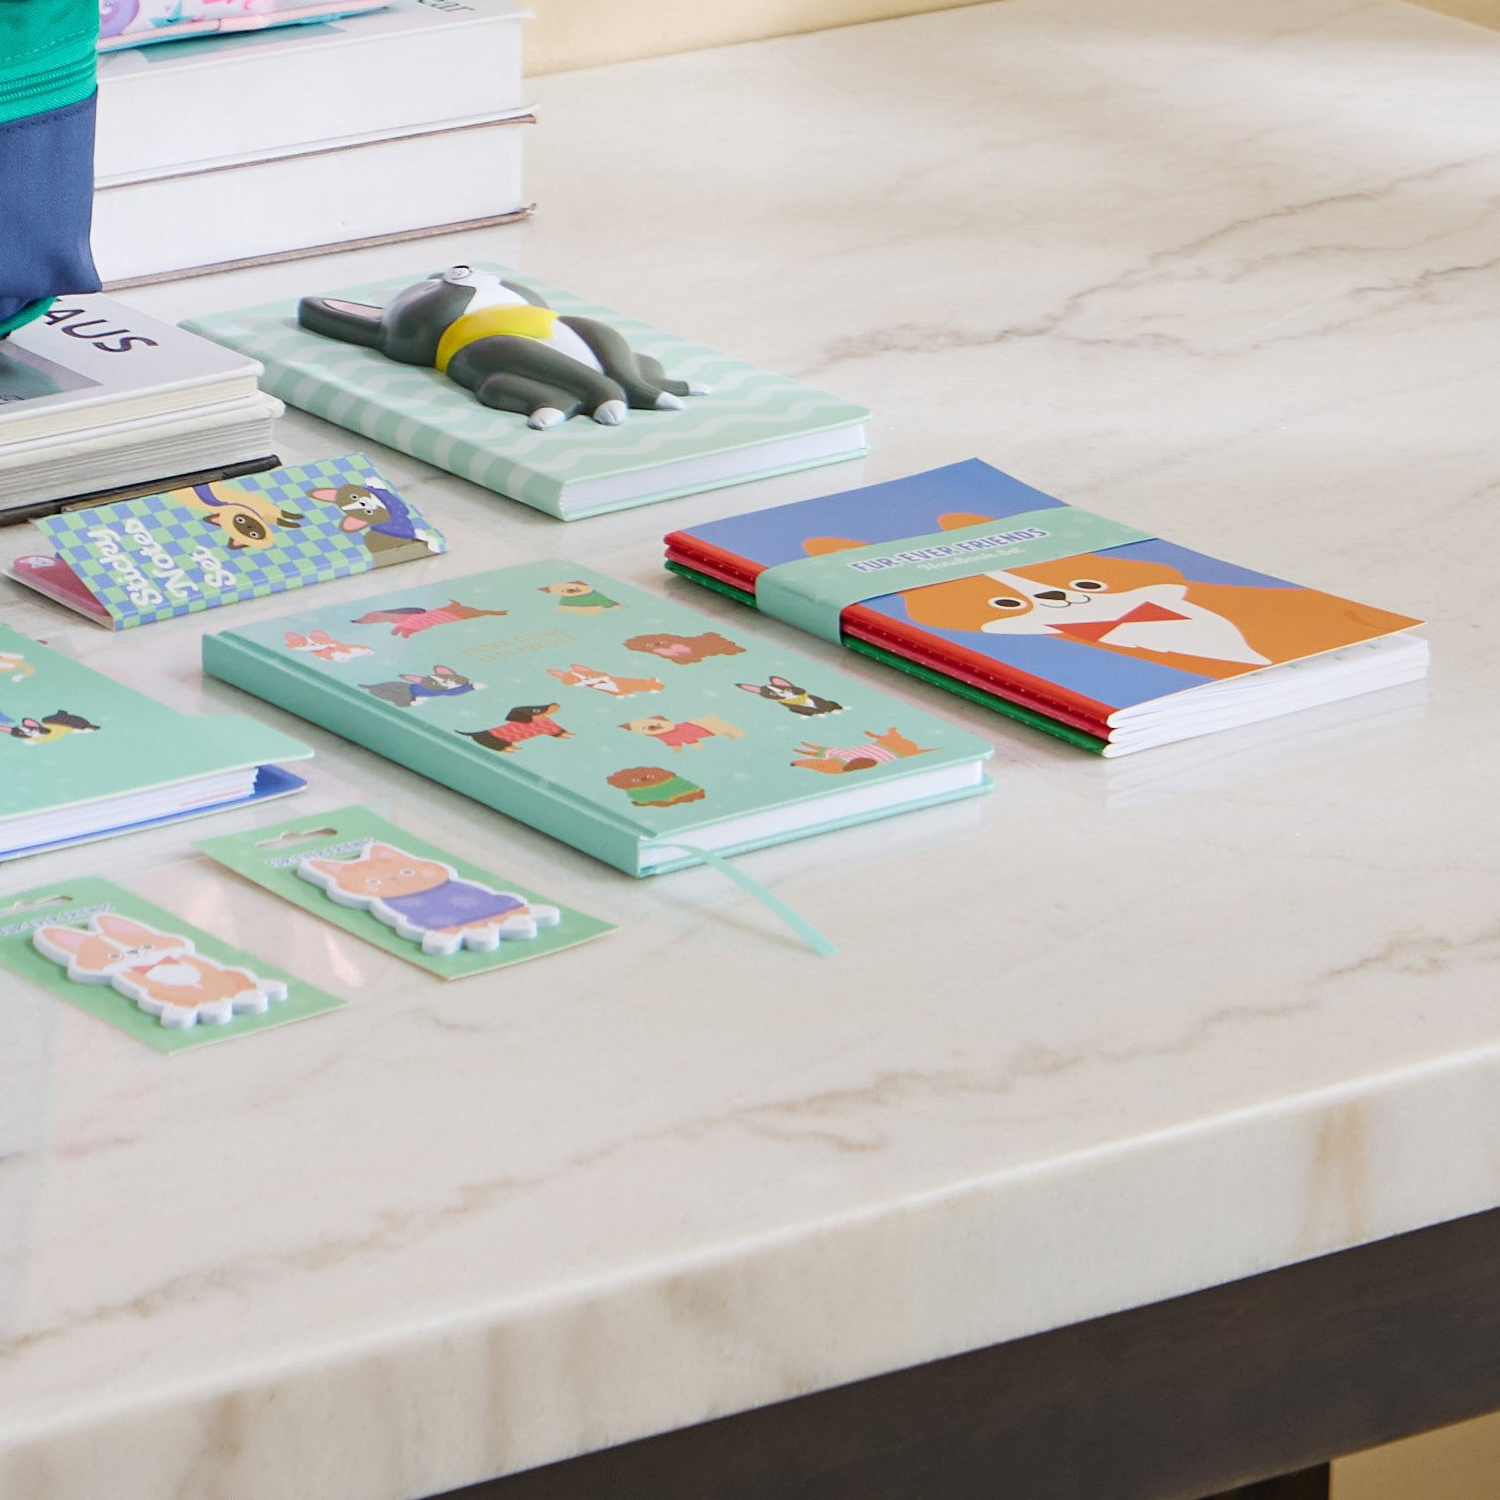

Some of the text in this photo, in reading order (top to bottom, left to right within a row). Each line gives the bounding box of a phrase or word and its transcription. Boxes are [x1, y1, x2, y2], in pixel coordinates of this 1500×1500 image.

[43, 306, 160, 353] AUS
[124, 516, 199, 598] Notes
[956, 526, 1049, 552] FRIENDS
[86, 528, 164, 606] Sticky
[190, 545, 237, 588] Set
